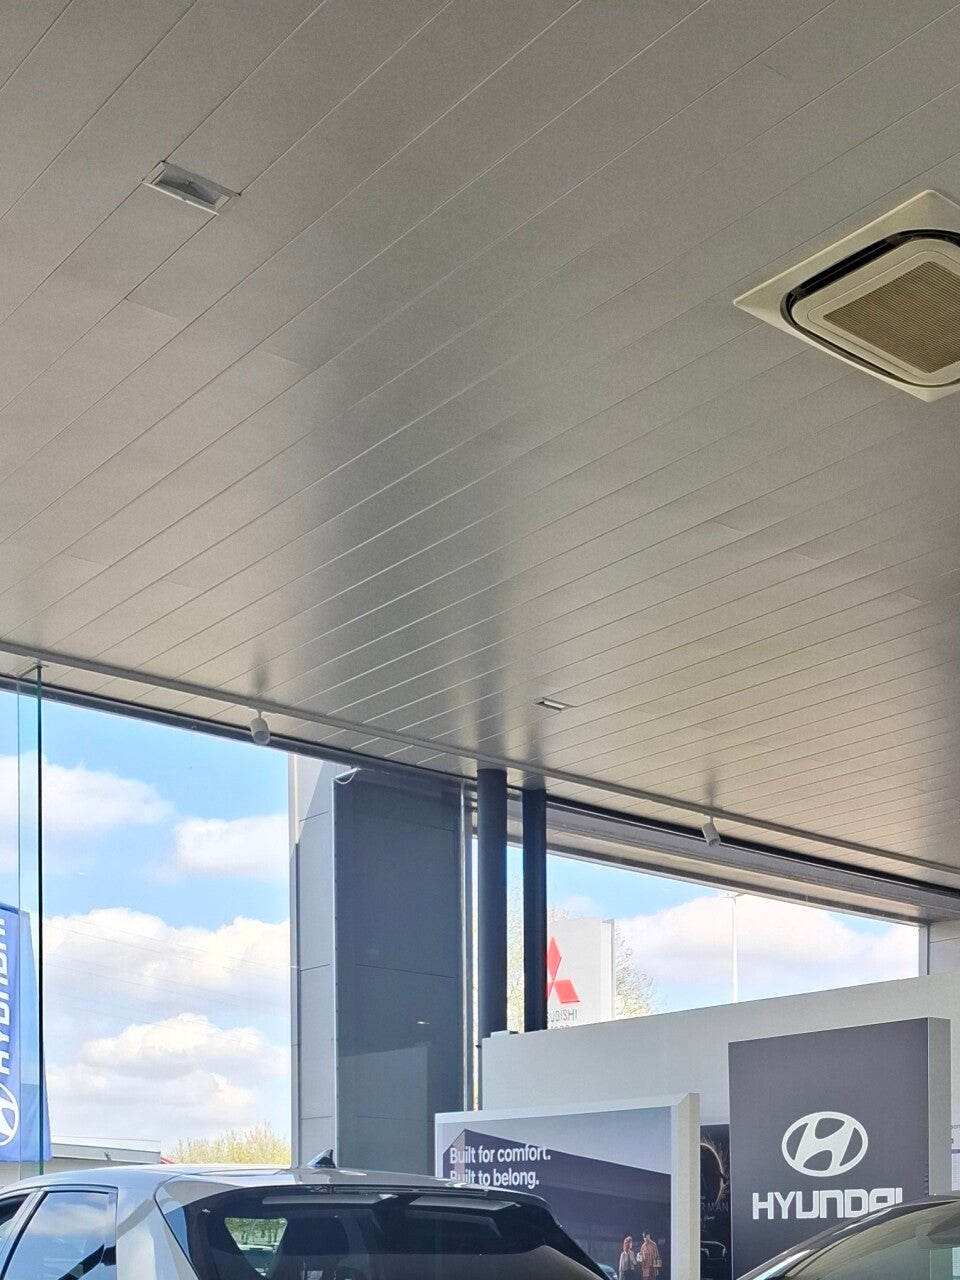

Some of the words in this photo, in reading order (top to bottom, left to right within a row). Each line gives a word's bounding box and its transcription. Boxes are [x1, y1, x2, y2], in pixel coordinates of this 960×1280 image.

[450, 1146, 476, 1164] Built
[479, 1146, 495, 1163] for
[497, 1144, 551, 1162] comfort.
[478, 1170, 491, 1186] to
[493, 1168, 539, 1189] belong.
[752, 1187, 903, 1220] HYUNDAI
